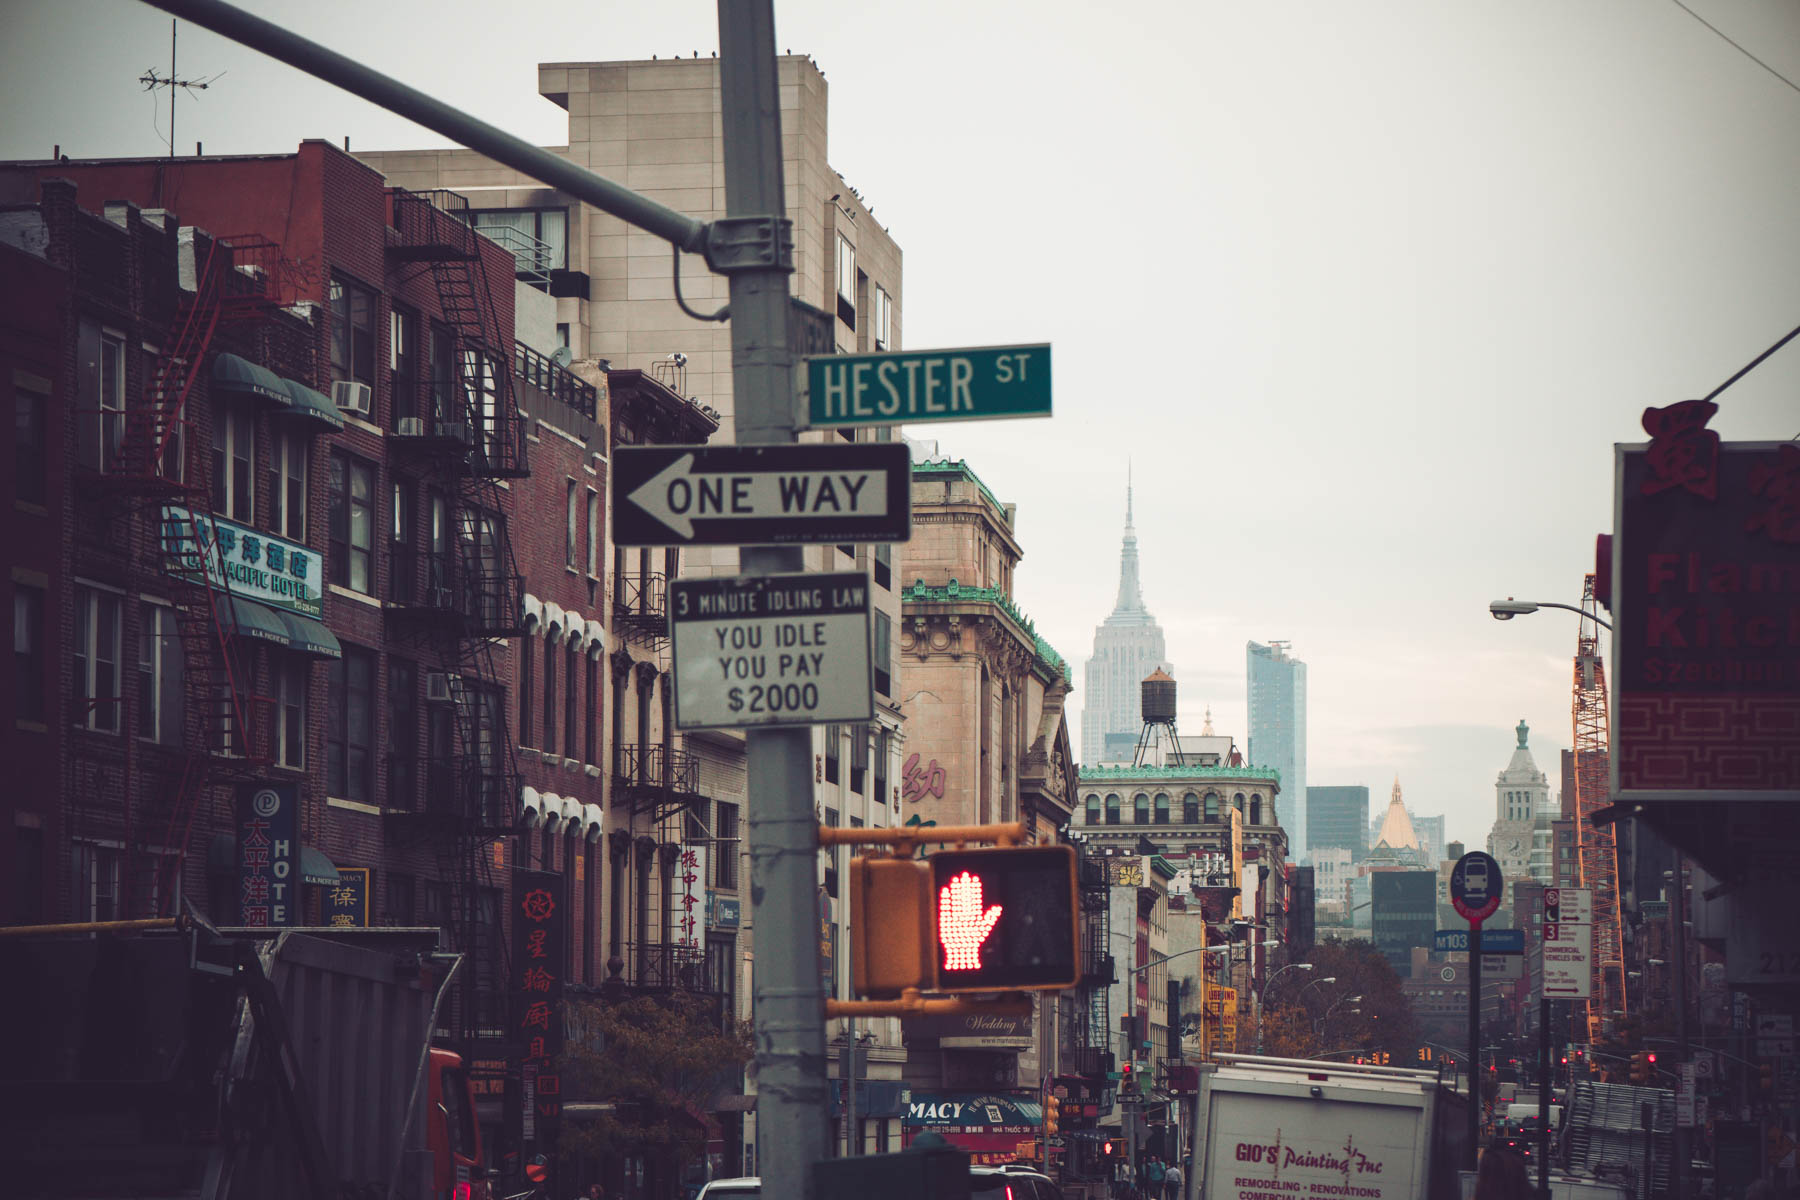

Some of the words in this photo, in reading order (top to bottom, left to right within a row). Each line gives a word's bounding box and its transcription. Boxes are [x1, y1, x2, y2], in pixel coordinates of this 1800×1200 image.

[824, 359, 974, 417] HESTER
[996, 354, 1031, 383] ST
[667, 477, 754, 514] ONE
[779, 475, 868, 512] WAY
[218, 559, 269, 589] PACIFIC
[271, 574, 309, 602] HOTEL
[679, 593, 689, 614] 3
[699, 591, 758, 613] MINUTE
[767, 588, 823, 611] IDLING
[831, 586, 865, 608] LAW
[716, 626, 768, 650] YOU
[775, 623, 827, 647] IDLE
[720, 656, 768, 679] YOU
[779, 653, 824, 677] PAY
[728, 682, 819, 713] $2000
[273, 839, 290, 923] HOTE
[1436, 934, 1468, 949] M103
[1547, 925, 1555, 939] 3
[1208, 989, 1236, 1001] LIGHING
[965, 1015, 1017, 1035] Wedding
[908, 1102, 965, 1119] MACY
[1236, 1143, 1279, 1165] GIO'S
[1283, 1146, 1350, 1176] Painting
[1235, 1177, 1301, 1193] REMODELING
[1309, 1183, 1382, 1199] RENOVATIONS
